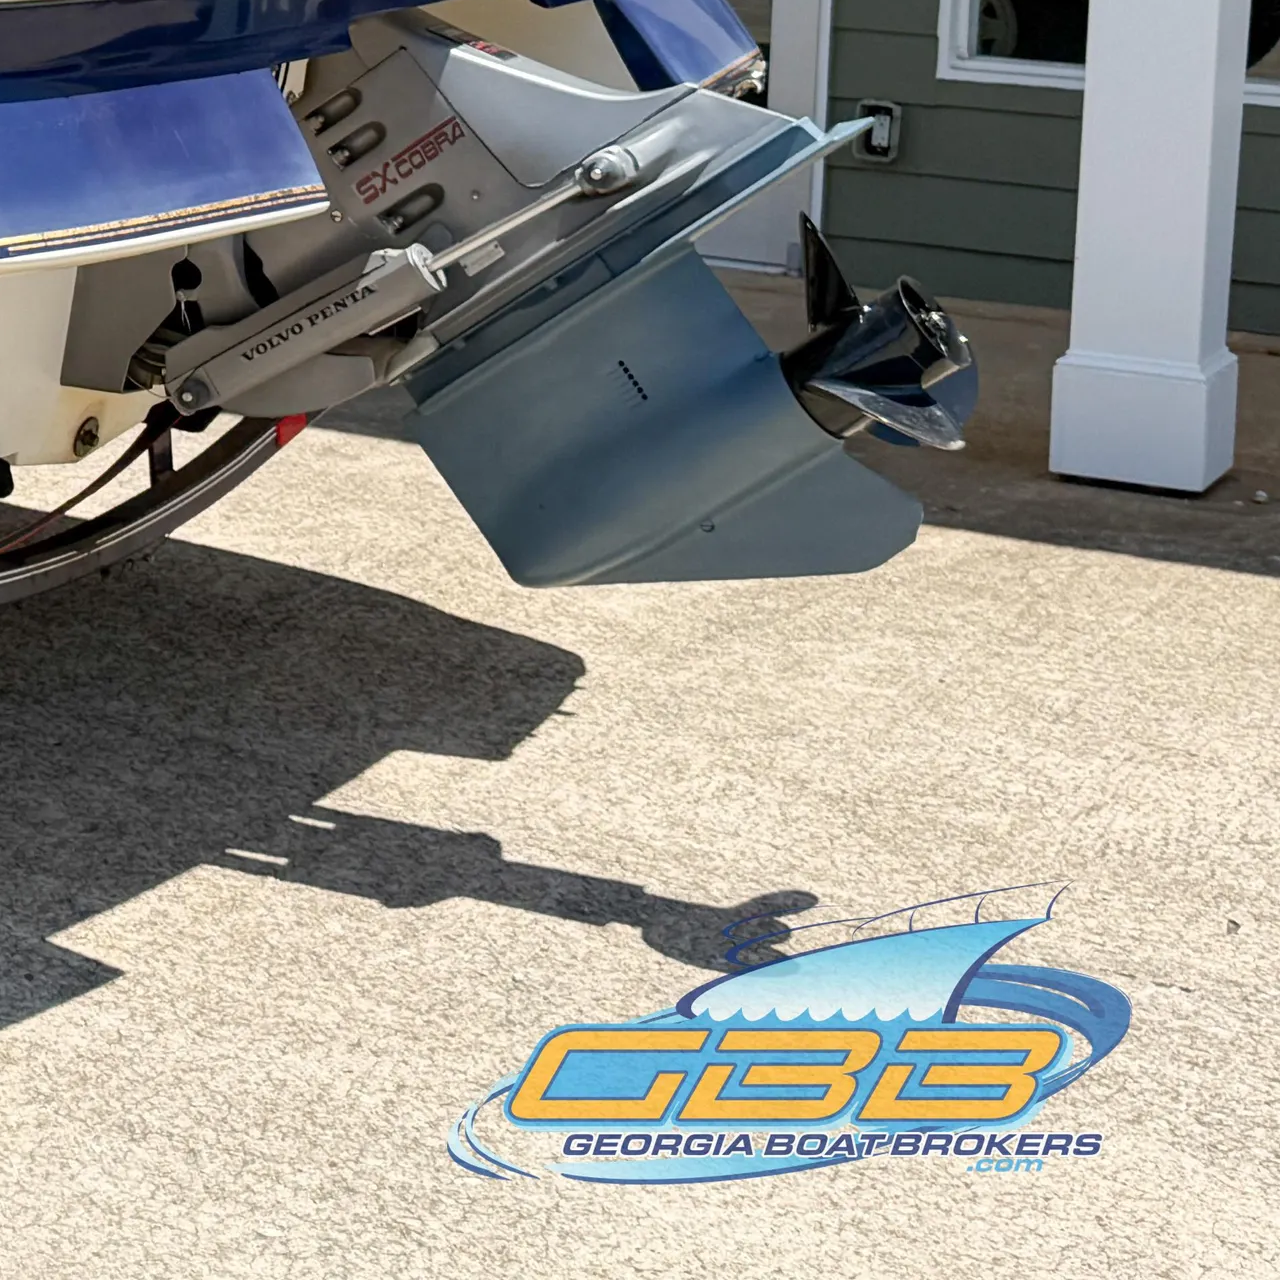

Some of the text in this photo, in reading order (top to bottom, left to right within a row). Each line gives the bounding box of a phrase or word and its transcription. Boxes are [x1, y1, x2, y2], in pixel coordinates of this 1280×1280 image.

[356, 120, 466, 204] SX COBRA
[241, 284, 378, 361] VOLVO PENTA
